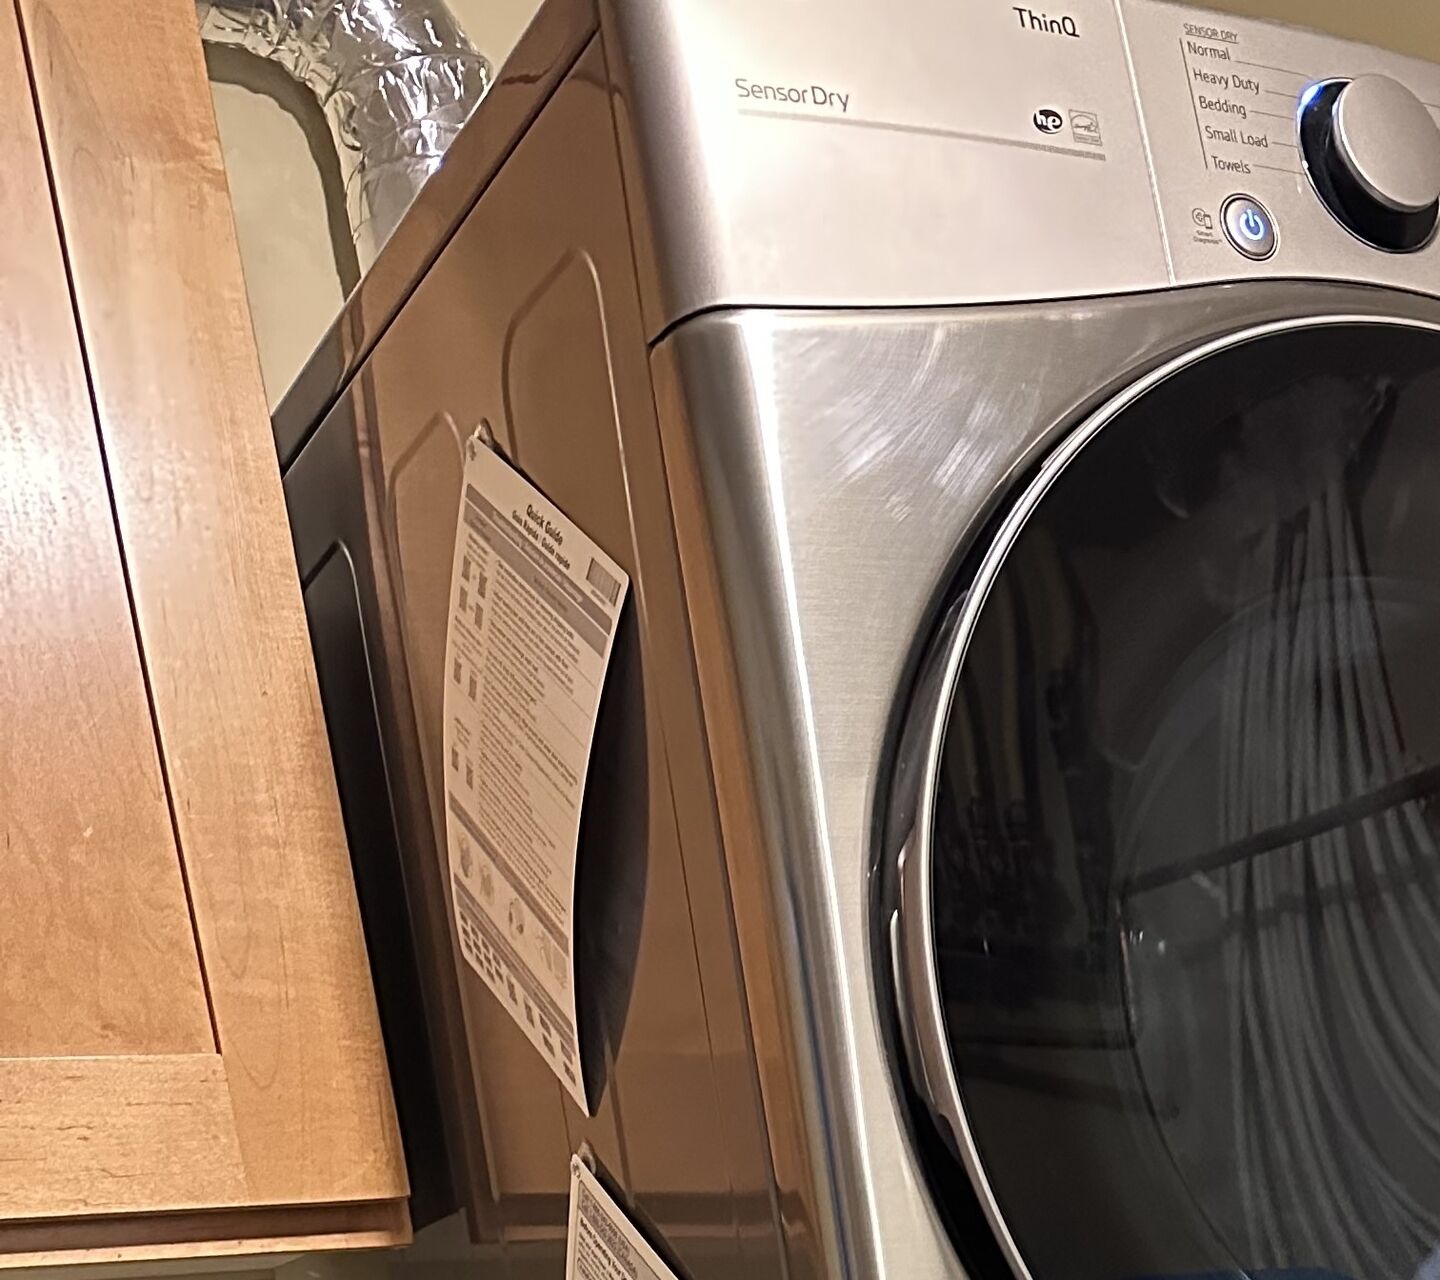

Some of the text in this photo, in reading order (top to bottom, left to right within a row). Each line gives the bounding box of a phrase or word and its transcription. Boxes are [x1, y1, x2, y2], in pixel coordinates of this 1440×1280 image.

[1013, 6, 1081, 38] ThinQ
[1183, 22, 1219, 38] SENSOR
[1186, 41, 1231, 61] Normal
[1193, 67, 1259, 95] Heavy Duty
[1198, 95, 1247, 119] Bedding
[1205, 125, 1268, 148] Small Load
[1211, 155, 1251, 174] Towels
